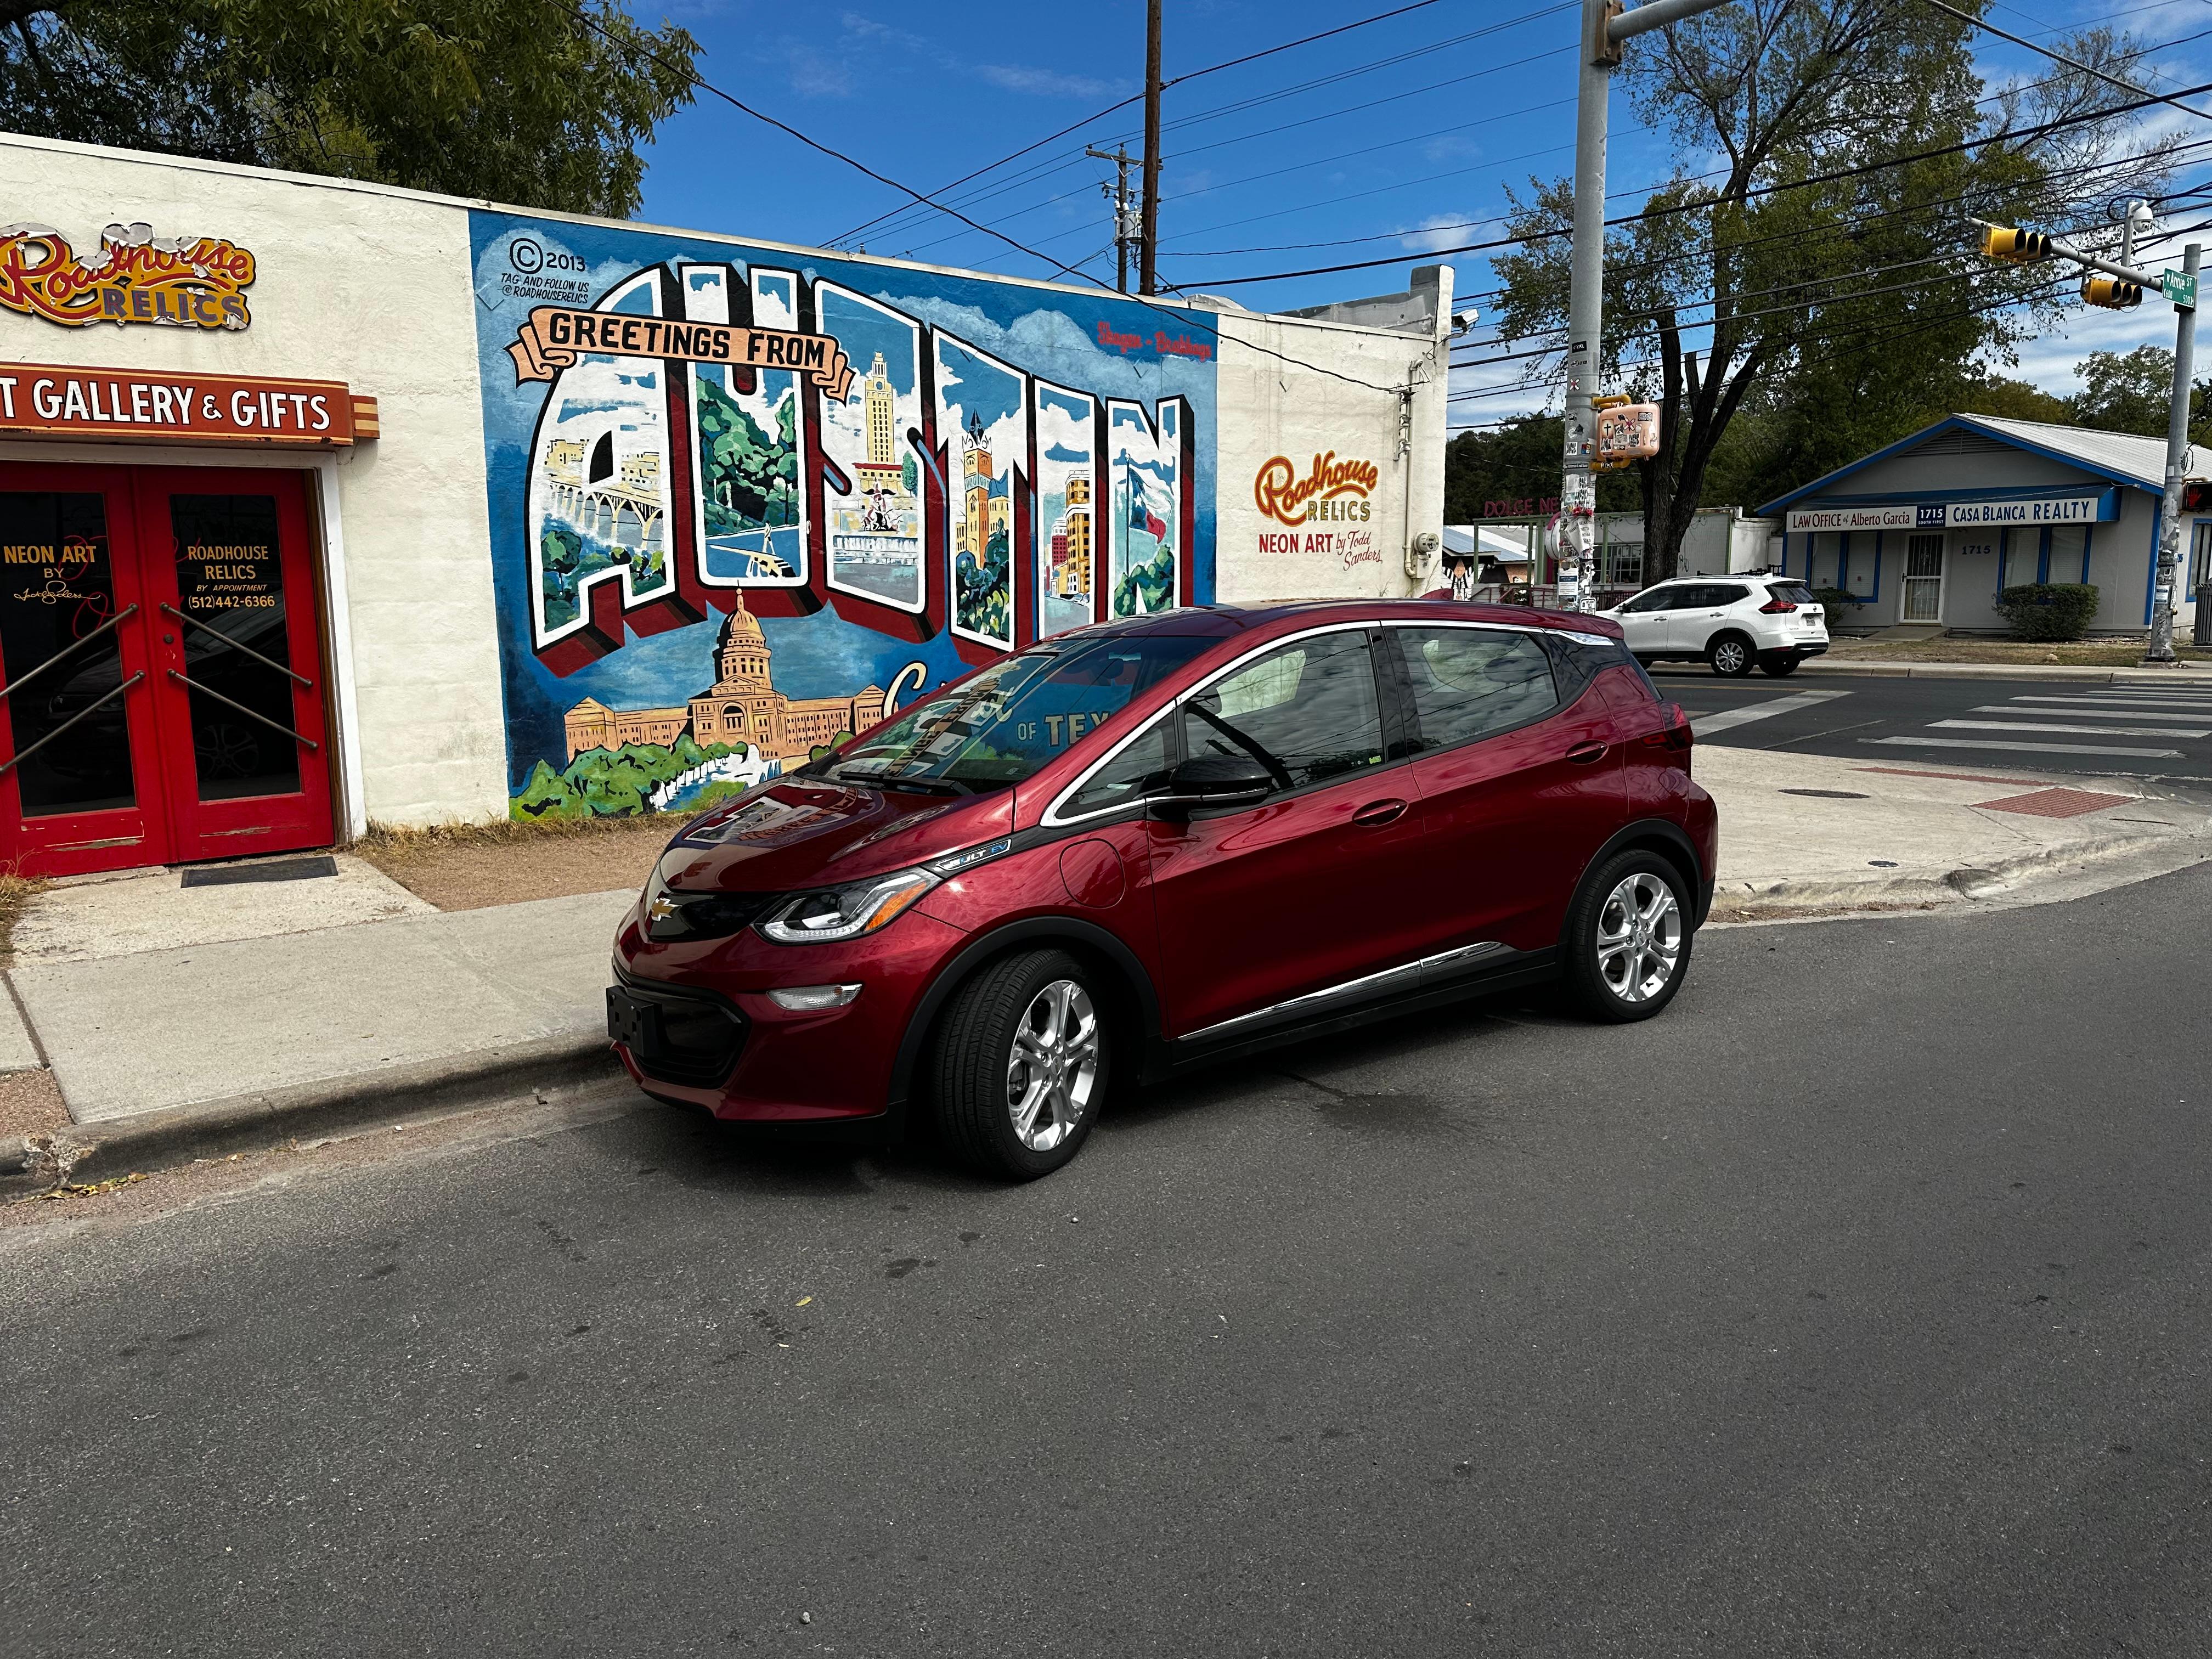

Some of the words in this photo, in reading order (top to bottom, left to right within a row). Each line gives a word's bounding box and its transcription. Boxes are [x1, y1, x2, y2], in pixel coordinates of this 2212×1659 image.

[546, 252, 586, 272] 2013
[0, 232, 250, 324] Roadhouse
[501, 273, 520, 284] TAG
[523, 275, 543, 287] AND
[544, 278, 577, 290] FOLLOW
[578, 282, 590, 292] US
[2170, 272, 2185, 290] Annie
[2186, 277, 2193, 286] ST
[502, 285, 589, 303] @ROADHOUSERELICS
[102, 287, 245, 321] RELICS
[550, 312, 730, 359] GREETINGS
[747, 335, 825, 369] FROM
[32, 379, 195, 426] GALLERY
[202, 394, 222, 420] &
[231, 390, 330, 430] GIFTS
[522, 260, 1196, 676] AUSTIN
[1255, 450, 1379, 527] Roadhouse
[1307, 500, 1370, 522] RELICS
[1484, 498, 1533, 517] DOLCE
[1920, 509, 1944, 519] 1715
[1953, 506, 1979, 522] CASA
[1983, 505, 2025, 521] BLANCA
[2033, 501, 2090, 520] REALTY
[1793, 514, 1811, 528] LAW
[1812, 513, 1841, 527] OFFICE
[1850, 513, 1881, 526] Alberto
[1883, 511, 1910, 525] Garcia
[1259, 534, 1299, 553] NEON
[1304, 533, 1334, 553] ART
[1335, 532, 1346, 556] by
[1347, 530, 1372, 550] Todd
[1962, 545, 1991, 554] 1715
[3, 545, 54, 563] NEON
[61, 545, 97, 563] ART
[188, 546, 269, 560] ROADHOUSE
[1343, 546, 1383, 571] Sanders
[44, 568, 64, 578] BY
[205, 565, 256, 579] RELICS
[1018, 721, 1036, 741] OF
[991, 843, 1007, 853] EV
